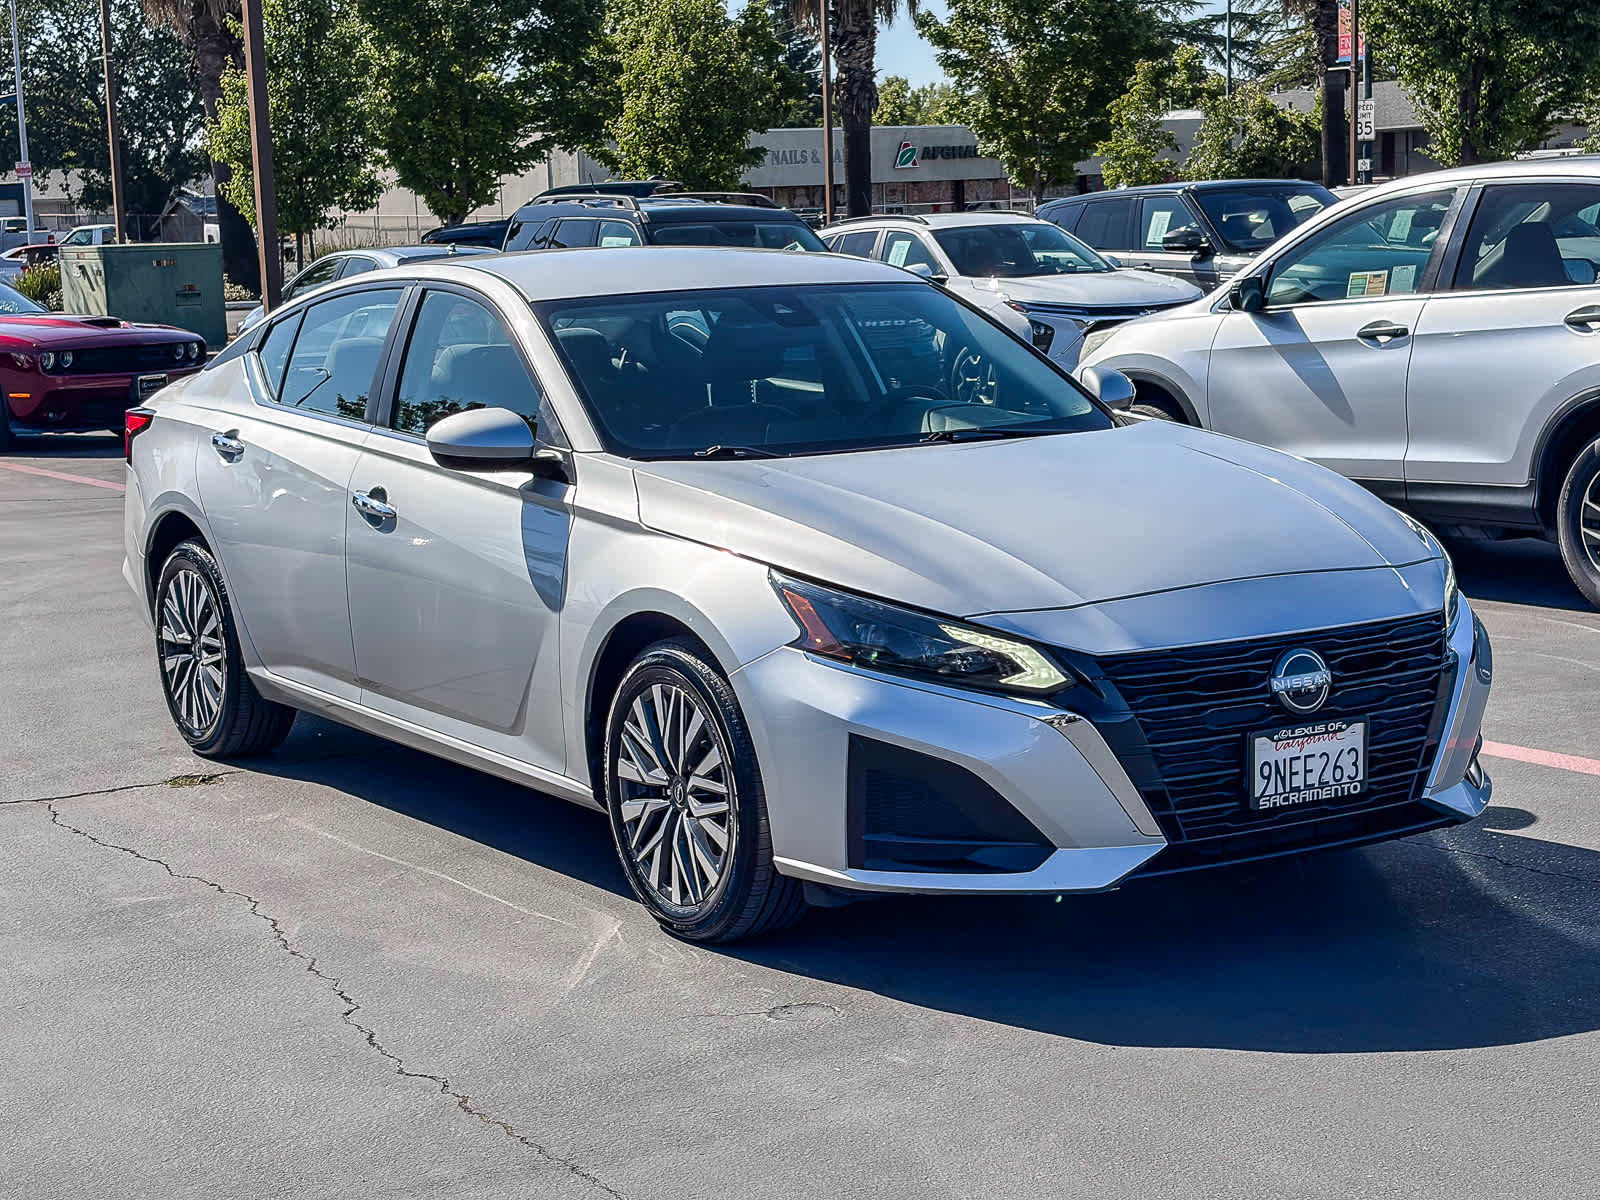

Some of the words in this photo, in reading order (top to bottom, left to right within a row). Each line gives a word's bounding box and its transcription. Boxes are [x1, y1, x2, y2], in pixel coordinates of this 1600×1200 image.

[1358, 112, 1371, 120] IMIT
[771, 149, 808, 166] NAILS
[811, 148, 822, 165] &
[1273, 670, 1332, 690] NISSAN
[1288, 724, 1327, 738] LEXUS
[1327, 721, 1343, 732] OF
[1259, 746, 1360, 797] 9NEE263
[1258, 782, 1361, 810] SACRAMENTO
